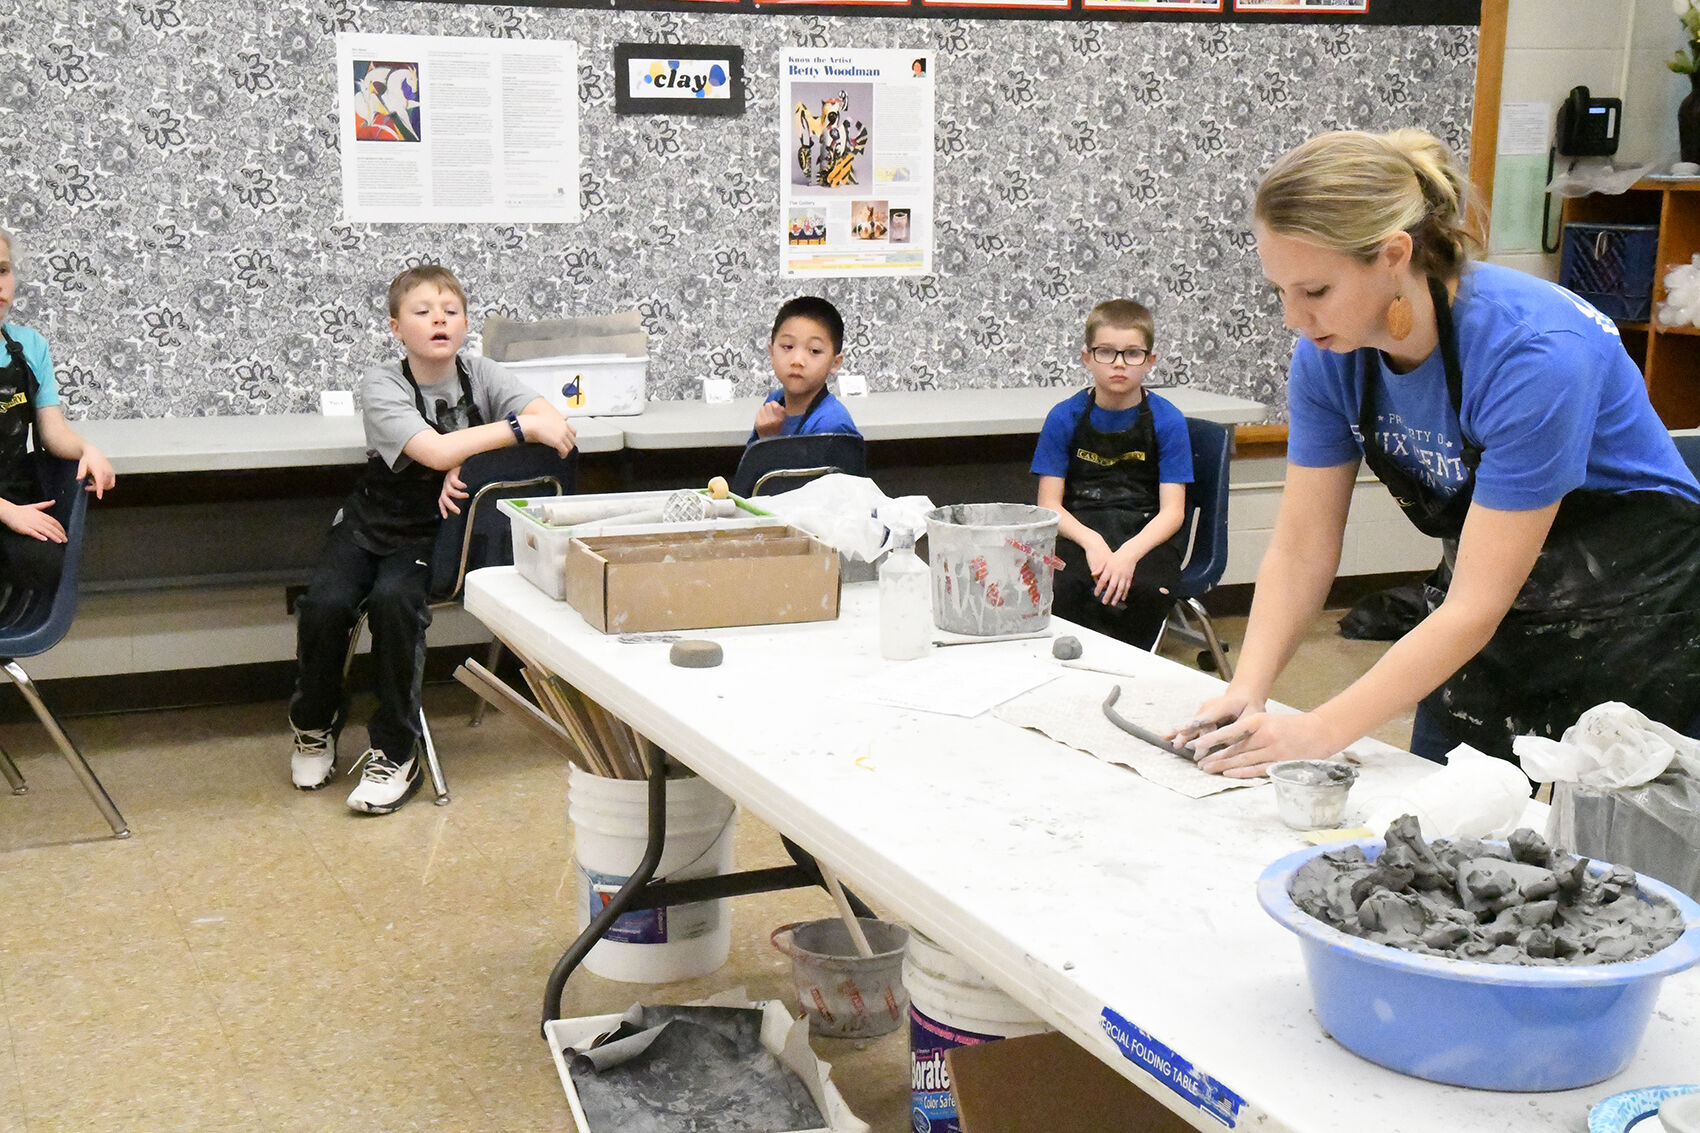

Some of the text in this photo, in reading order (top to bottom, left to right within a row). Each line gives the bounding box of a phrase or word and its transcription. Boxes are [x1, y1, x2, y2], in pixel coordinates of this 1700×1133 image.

[653, 69, 707, 93] clay
[789, 65, 880, 78] Betty Woodman
[1131, 1038, 1172, 1077] FOLDING
[1172, 1067, 1199, 1095] TABLE
[923, 1093, 956, 1110] Color Safe
